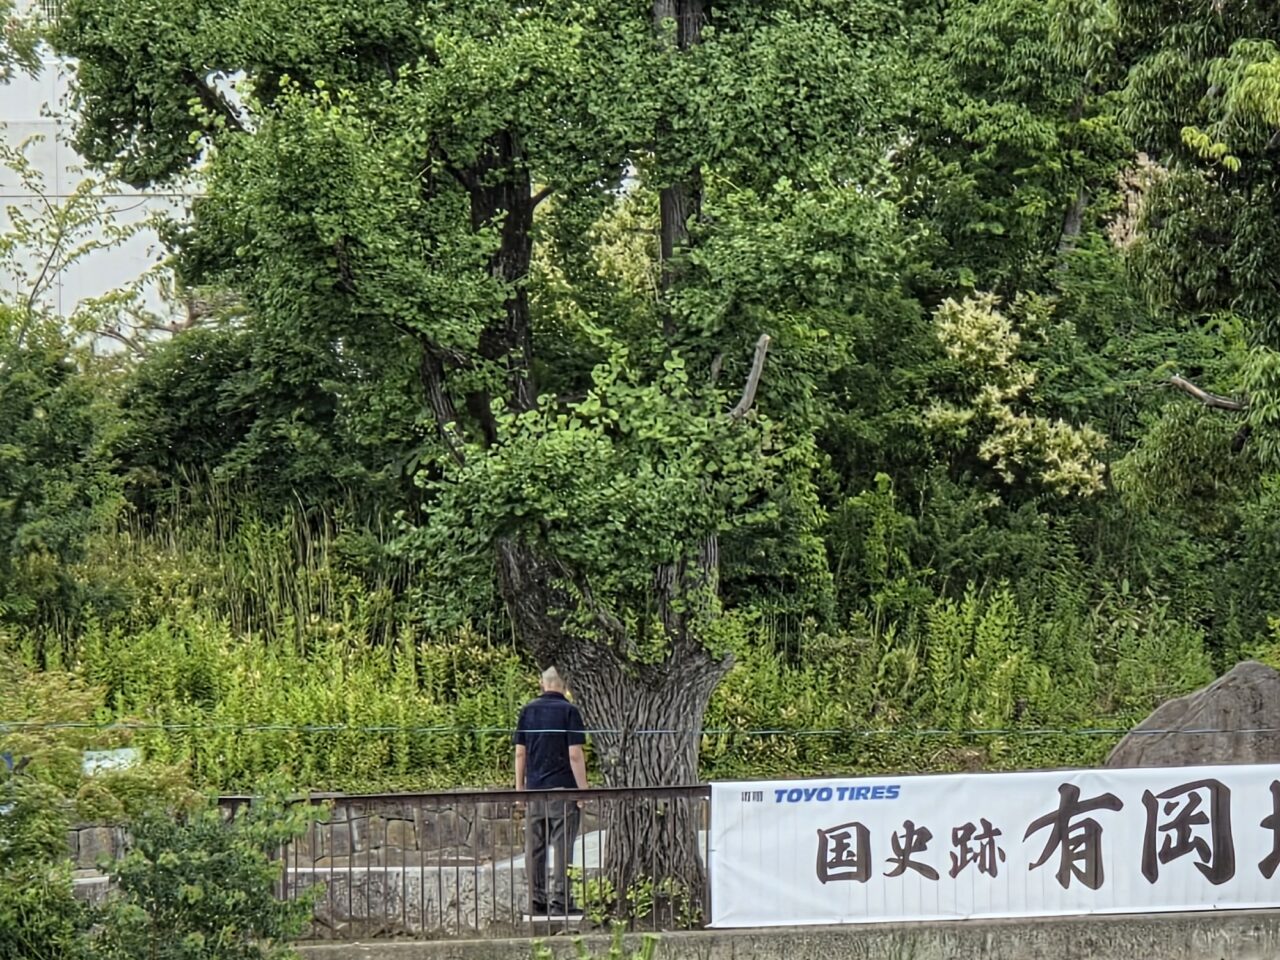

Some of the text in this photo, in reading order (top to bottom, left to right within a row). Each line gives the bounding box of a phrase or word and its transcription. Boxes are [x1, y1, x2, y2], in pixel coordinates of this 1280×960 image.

[774, 787, 833, 803] TOYO
[836, 785, 901, 801] TIRES
[816, 817, 1006, 885] 国史跡
